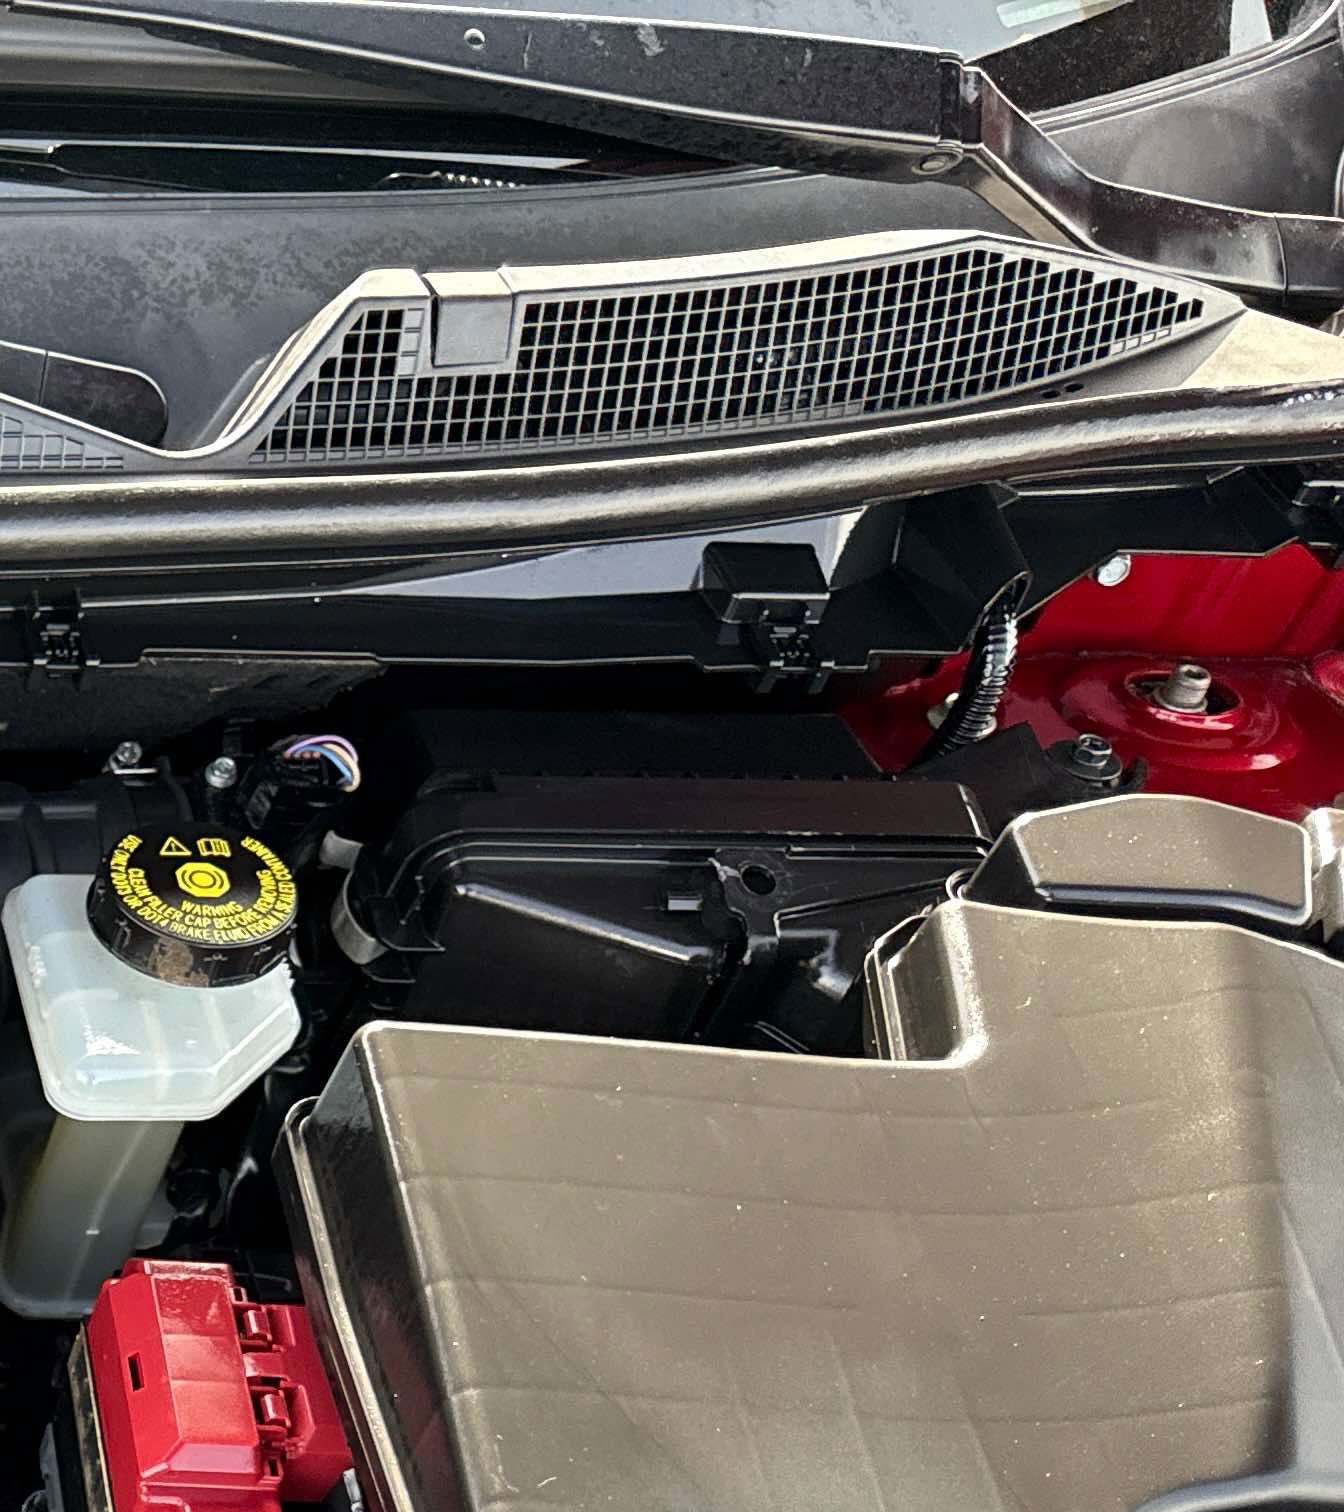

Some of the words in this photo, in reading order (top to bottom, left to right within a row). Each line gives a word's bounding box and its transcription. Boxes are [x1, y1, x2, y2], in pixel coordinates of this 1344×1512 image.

[241, 836, 292, 880] CONTAINER
[128, 868, 153, 897] CLEAN
[143, 895, 183, 921] FILLER
[184, 913, 211, 928] CAP
[213, 908, 263, 929] BEFORE
[253, 869, 278, 914] REMOVING
[180, 900, 243, 916] WARNING
[274, 881, 296, 913] SEALED
[137, 906, 170, 927] DOT4
[169, 921, 212, 941] BRAKE
